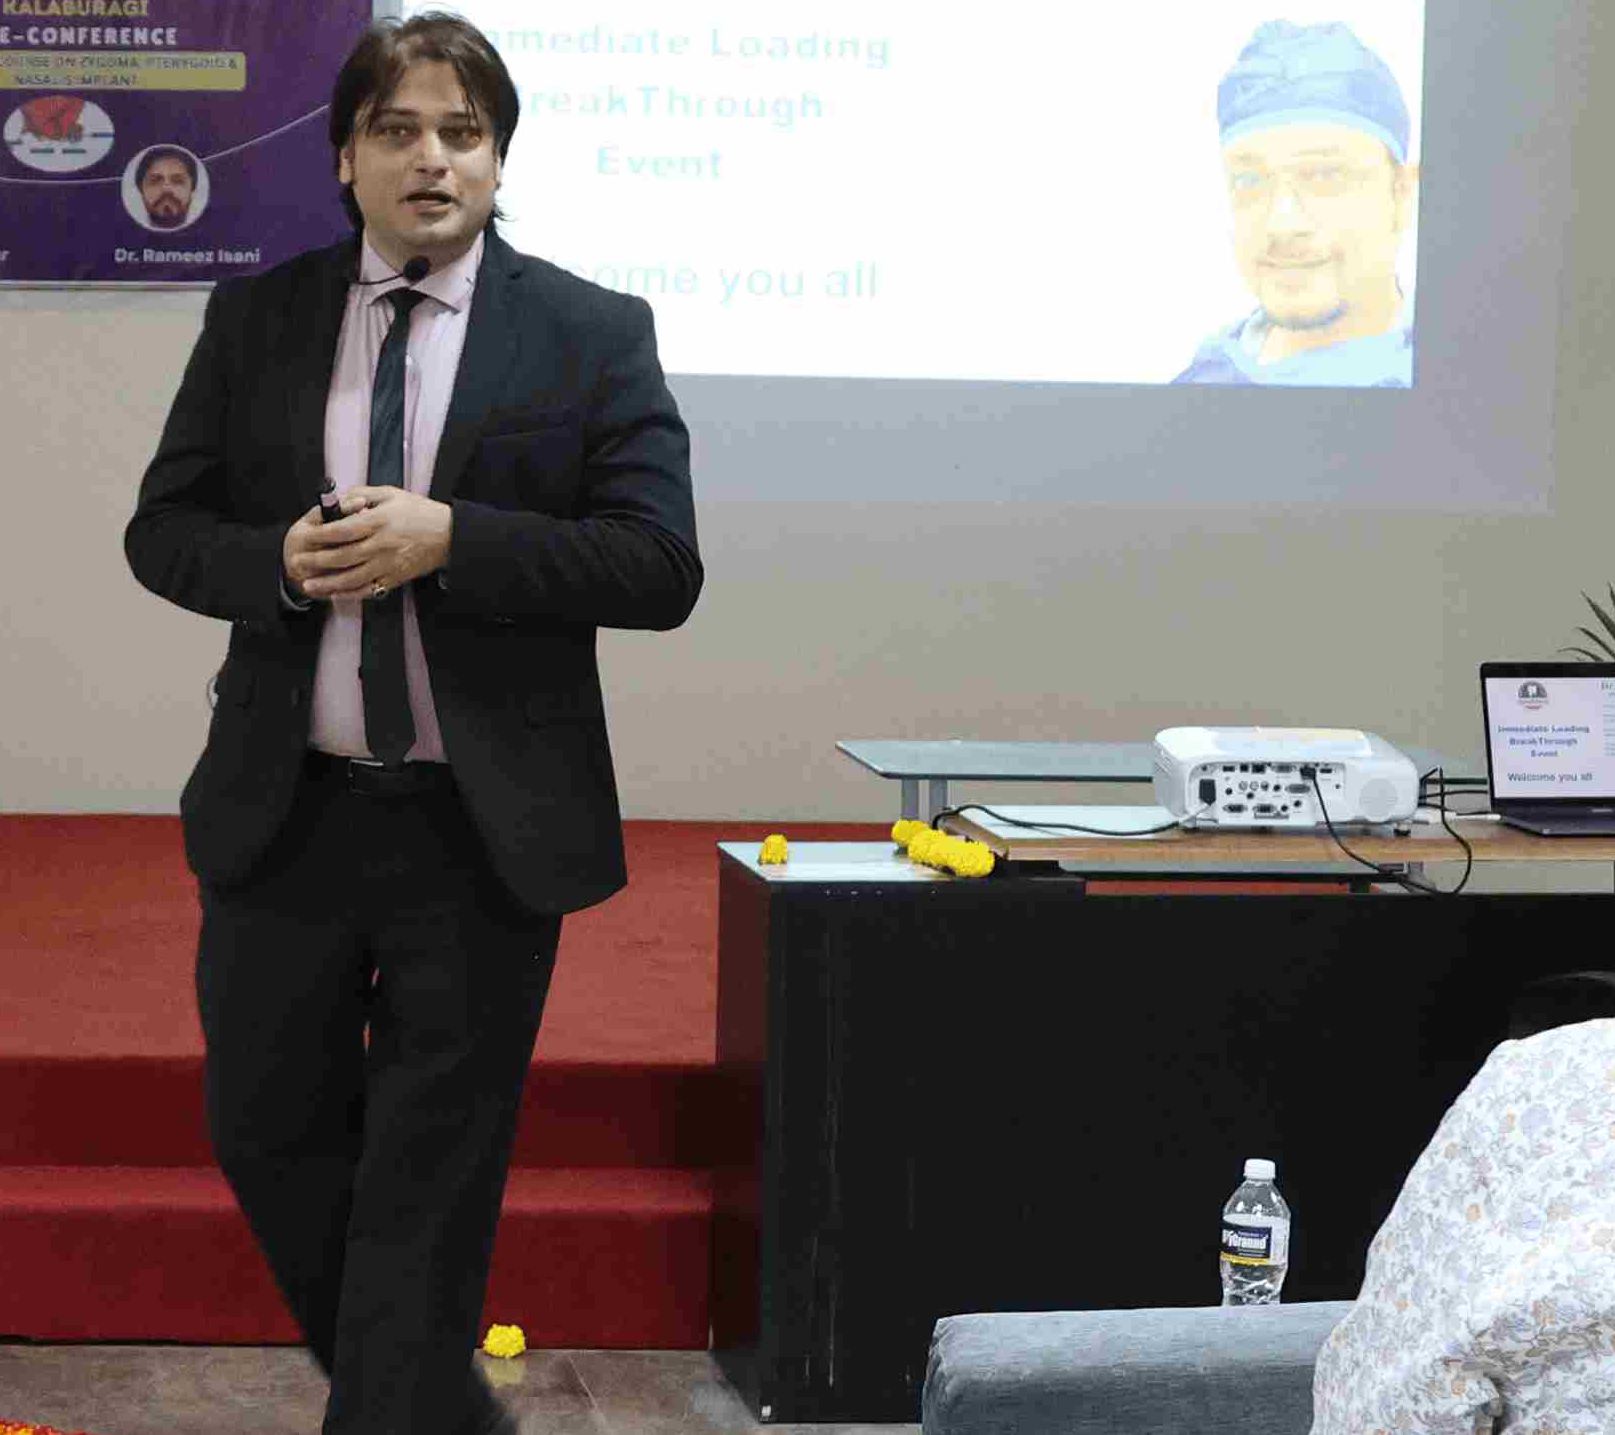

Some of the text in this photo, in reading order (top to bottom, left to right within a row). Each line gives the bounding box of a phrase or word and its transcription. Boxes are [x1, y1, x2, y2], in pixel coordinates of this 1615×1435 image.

[482, 24, 892, 69] mmediate Loading
[519, 84, 825, 132] reakThrough
[595, 144, 723, 180] Event
[114, 249, 260, 264] Dr. Rameez Isani
[719, 268, 805, 308] you
[824, 261, 879, 299] all
[1508, 773, 1556, 783] Welcome
[1558, 774, 1577, 783] you
